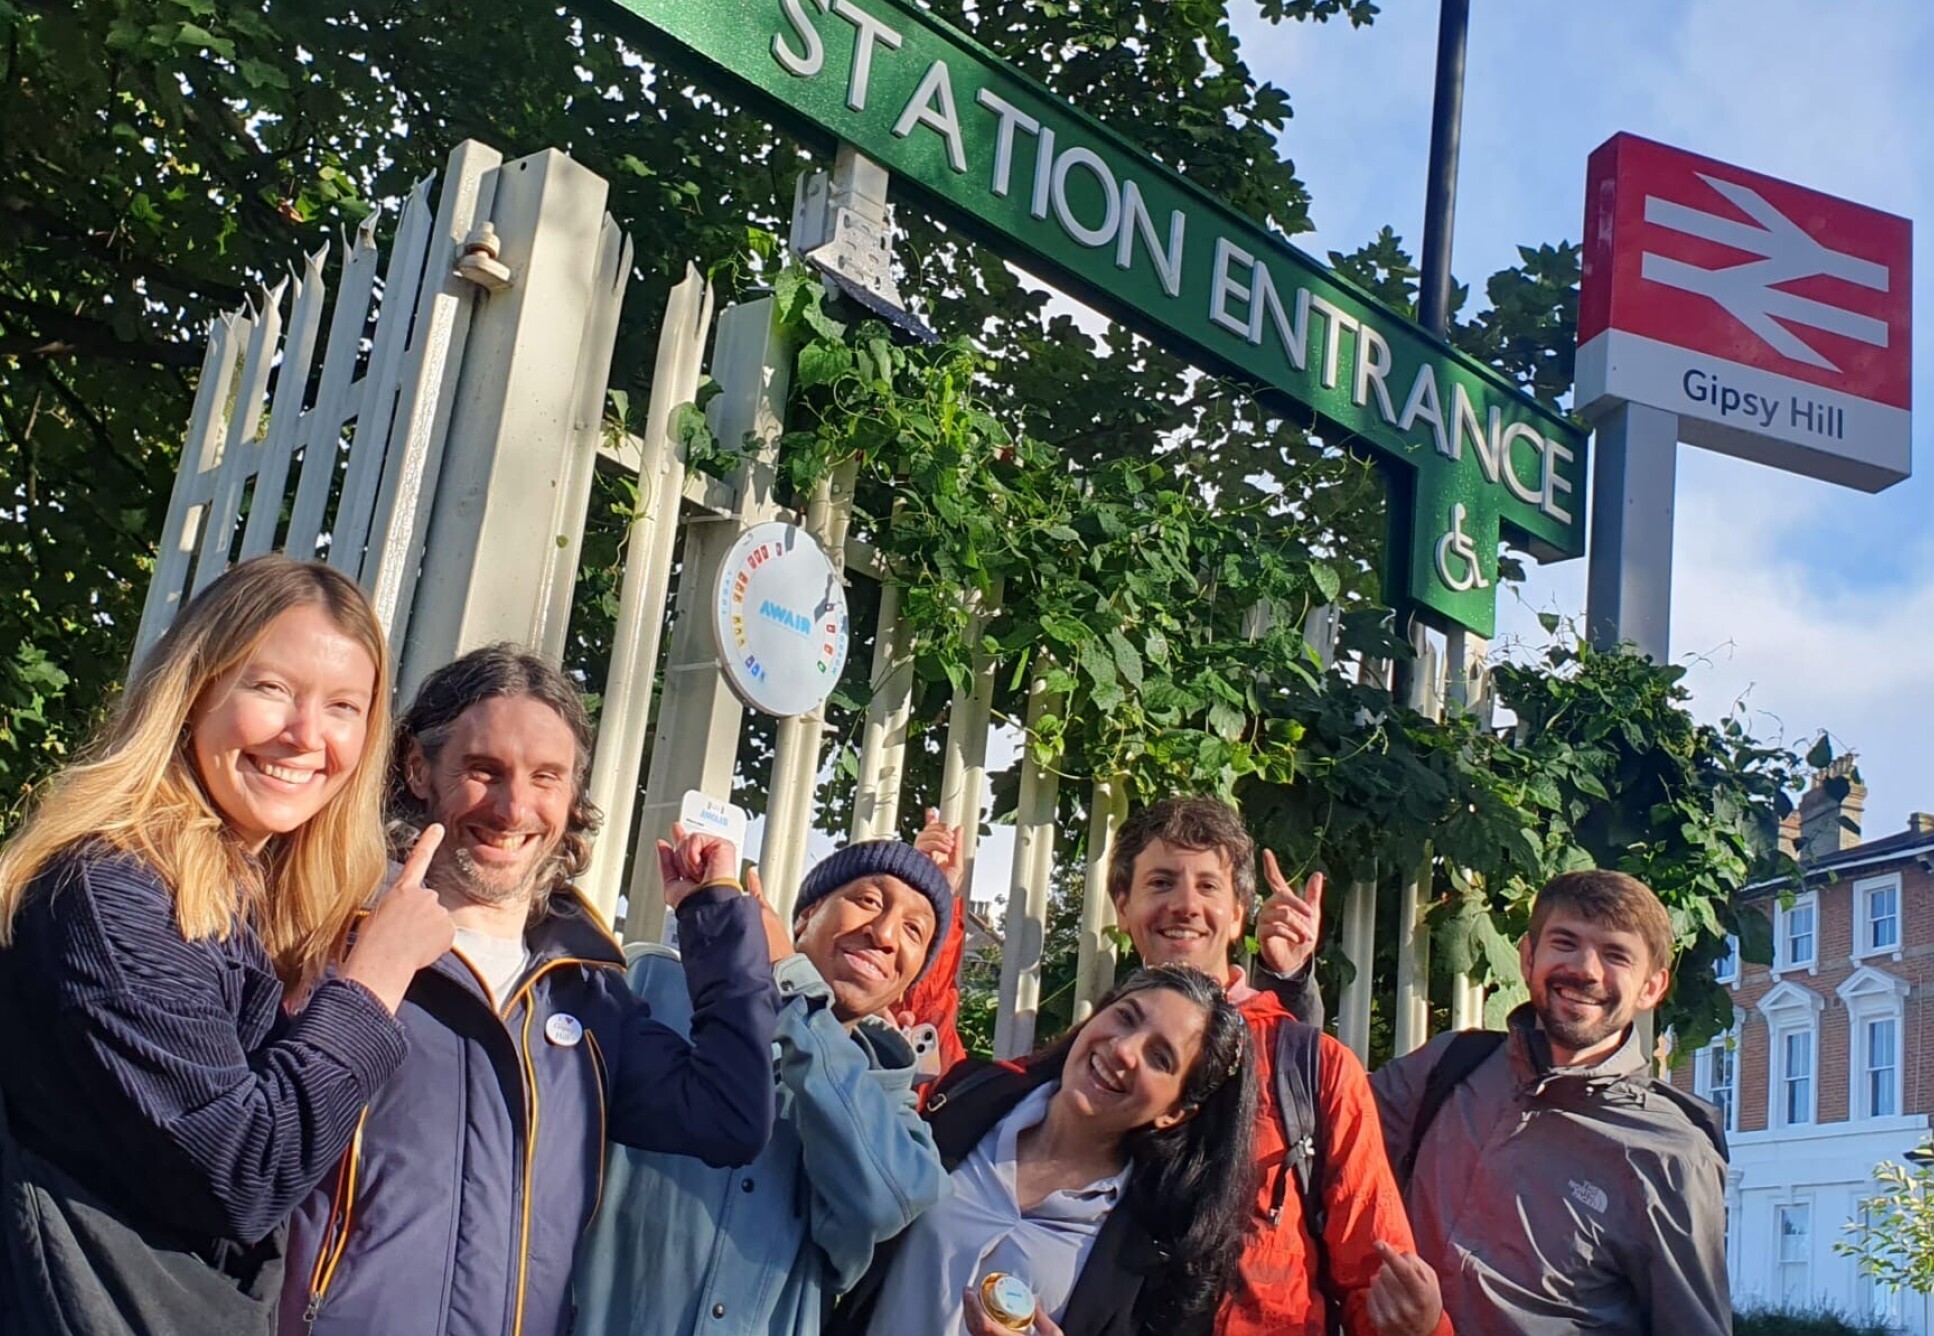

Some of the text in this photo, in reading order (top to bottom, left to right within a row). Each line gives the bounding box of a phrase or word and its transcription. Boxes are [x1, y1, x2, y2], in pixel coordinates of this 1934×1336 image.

[771, 0, 1574, 525] STATION ENTRANCE
[1683, 369, 1844, 440] Gipsy Hill
[760, 600, 811, 635] AWAIR
